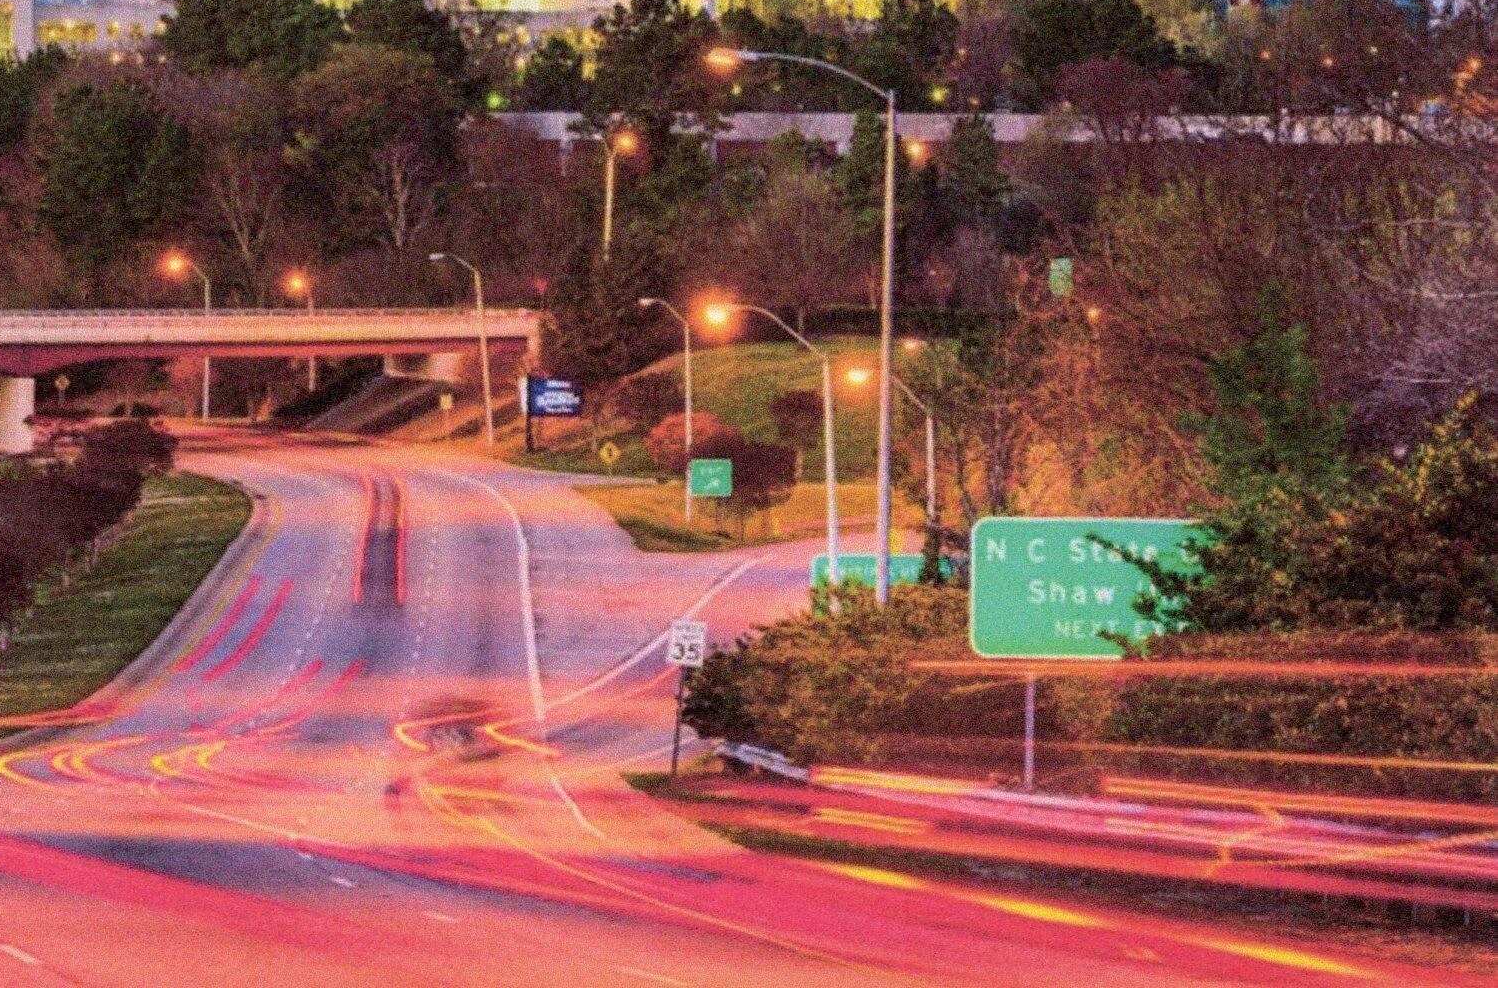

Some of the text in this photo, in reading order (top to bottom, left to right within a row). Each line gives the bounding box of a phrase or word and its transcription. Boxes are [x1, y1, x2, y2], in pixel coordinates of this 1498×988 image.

[987, 537, 1007, 562] N
[1027, 537, 1047, 563] C
[1028, 579, 1115, 606] Shaw
[672, 642, 700, 661] 35
